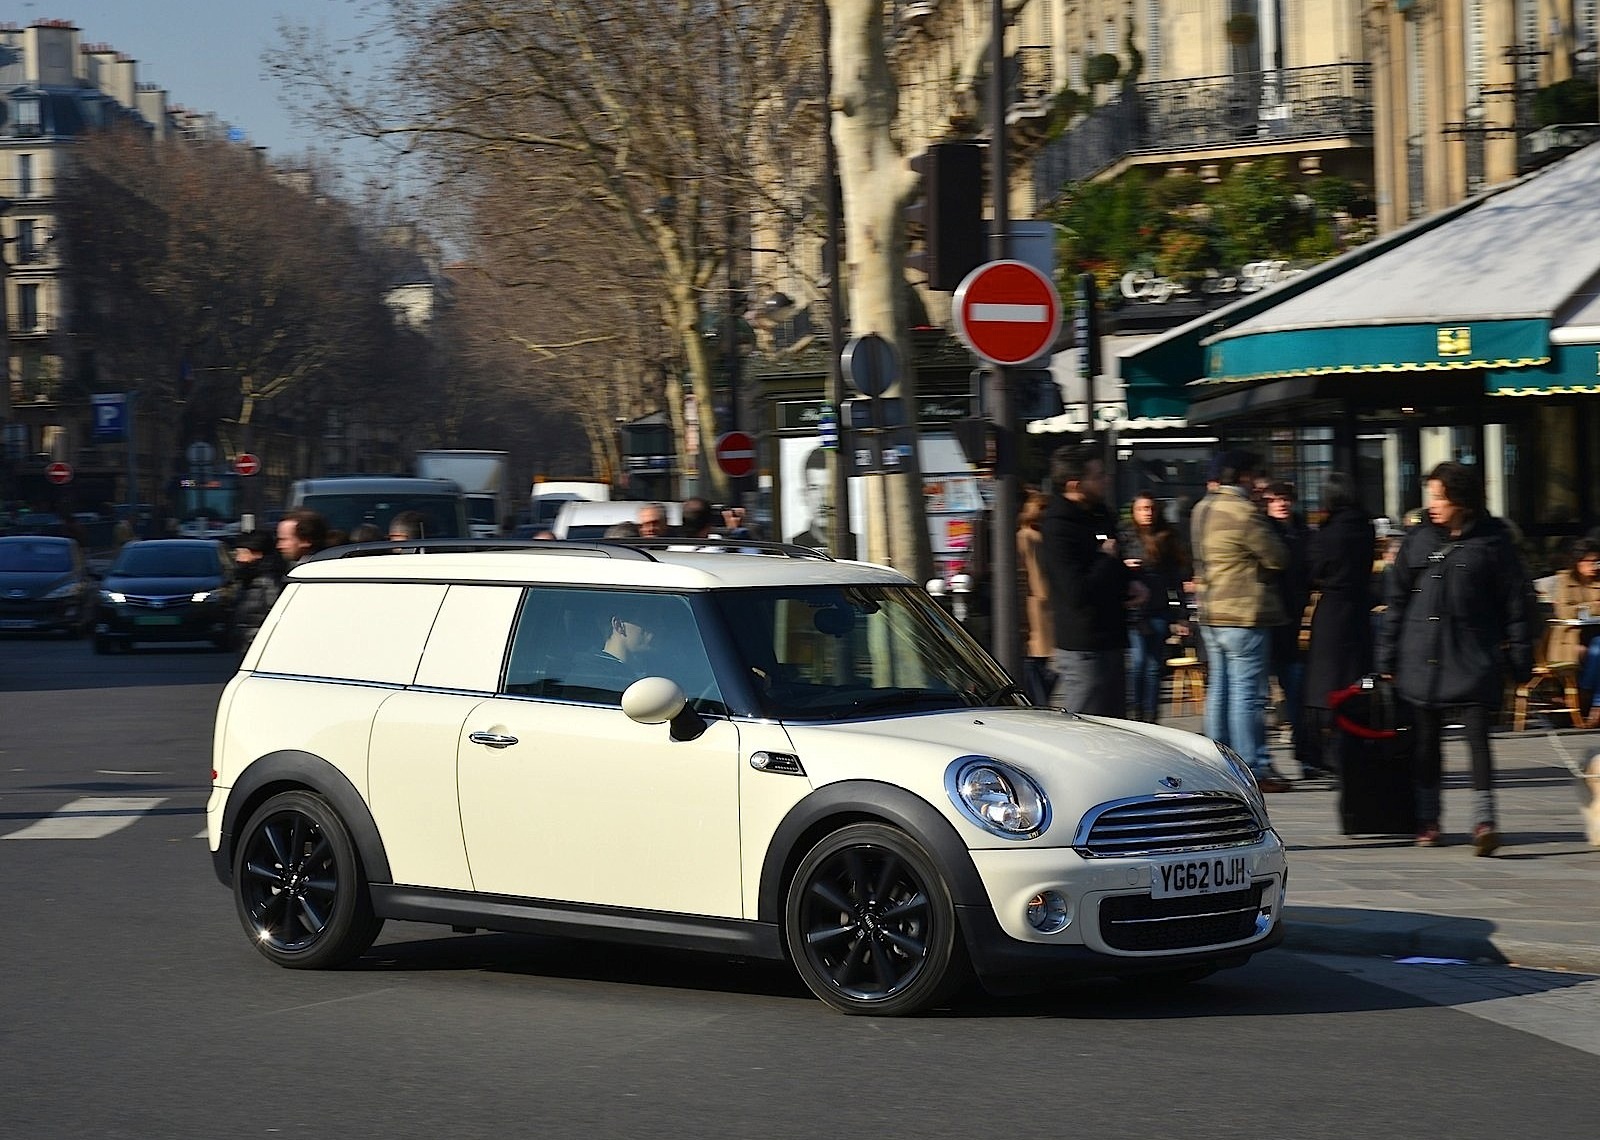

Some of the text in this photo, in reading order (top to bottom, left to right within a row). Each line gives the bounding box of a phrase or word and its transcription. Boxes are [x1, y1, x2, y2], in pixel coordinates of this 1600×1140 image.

[99, 405, 119, 426] P
[1160, 857, 1245, 892] YG62 OJH
